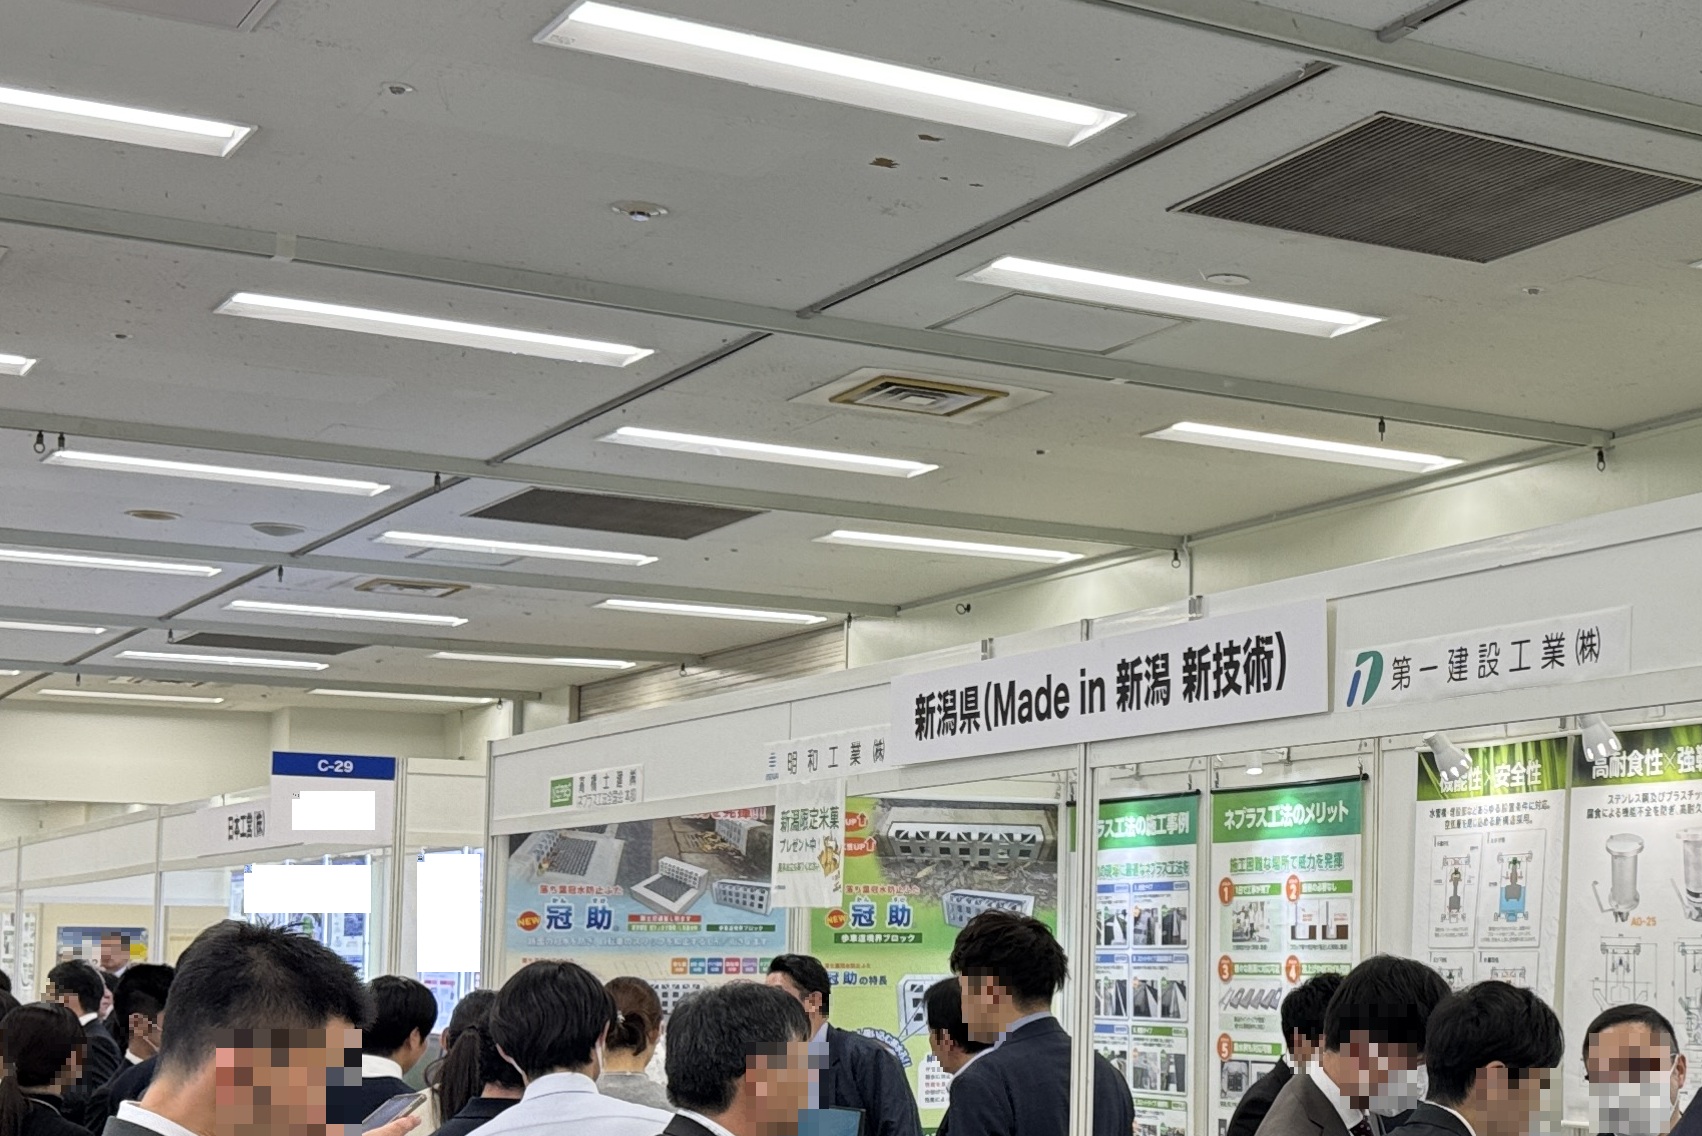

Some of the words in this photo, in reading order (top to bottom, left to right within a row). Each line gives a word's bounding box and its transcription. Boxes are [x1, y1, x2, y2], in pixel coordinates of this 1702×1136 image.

[915, 674, 1069, 741] 新潟県(Made
[1080, 668, 1106, 716] in
[1116, 652, 1170, 713] 新潟
[1182, 631, 1287, 703] 新技術)
[317, 759, 354, 773] C-29
[1224, 800, 1349, 830] ネプラス工法のメリット
[1289, 884, 1298, 900] 2
[1221, 964, 1229, 980] 3
[1289, 964, 1298, 980] 4
[1221, 1044, 1229, 1060] 5
